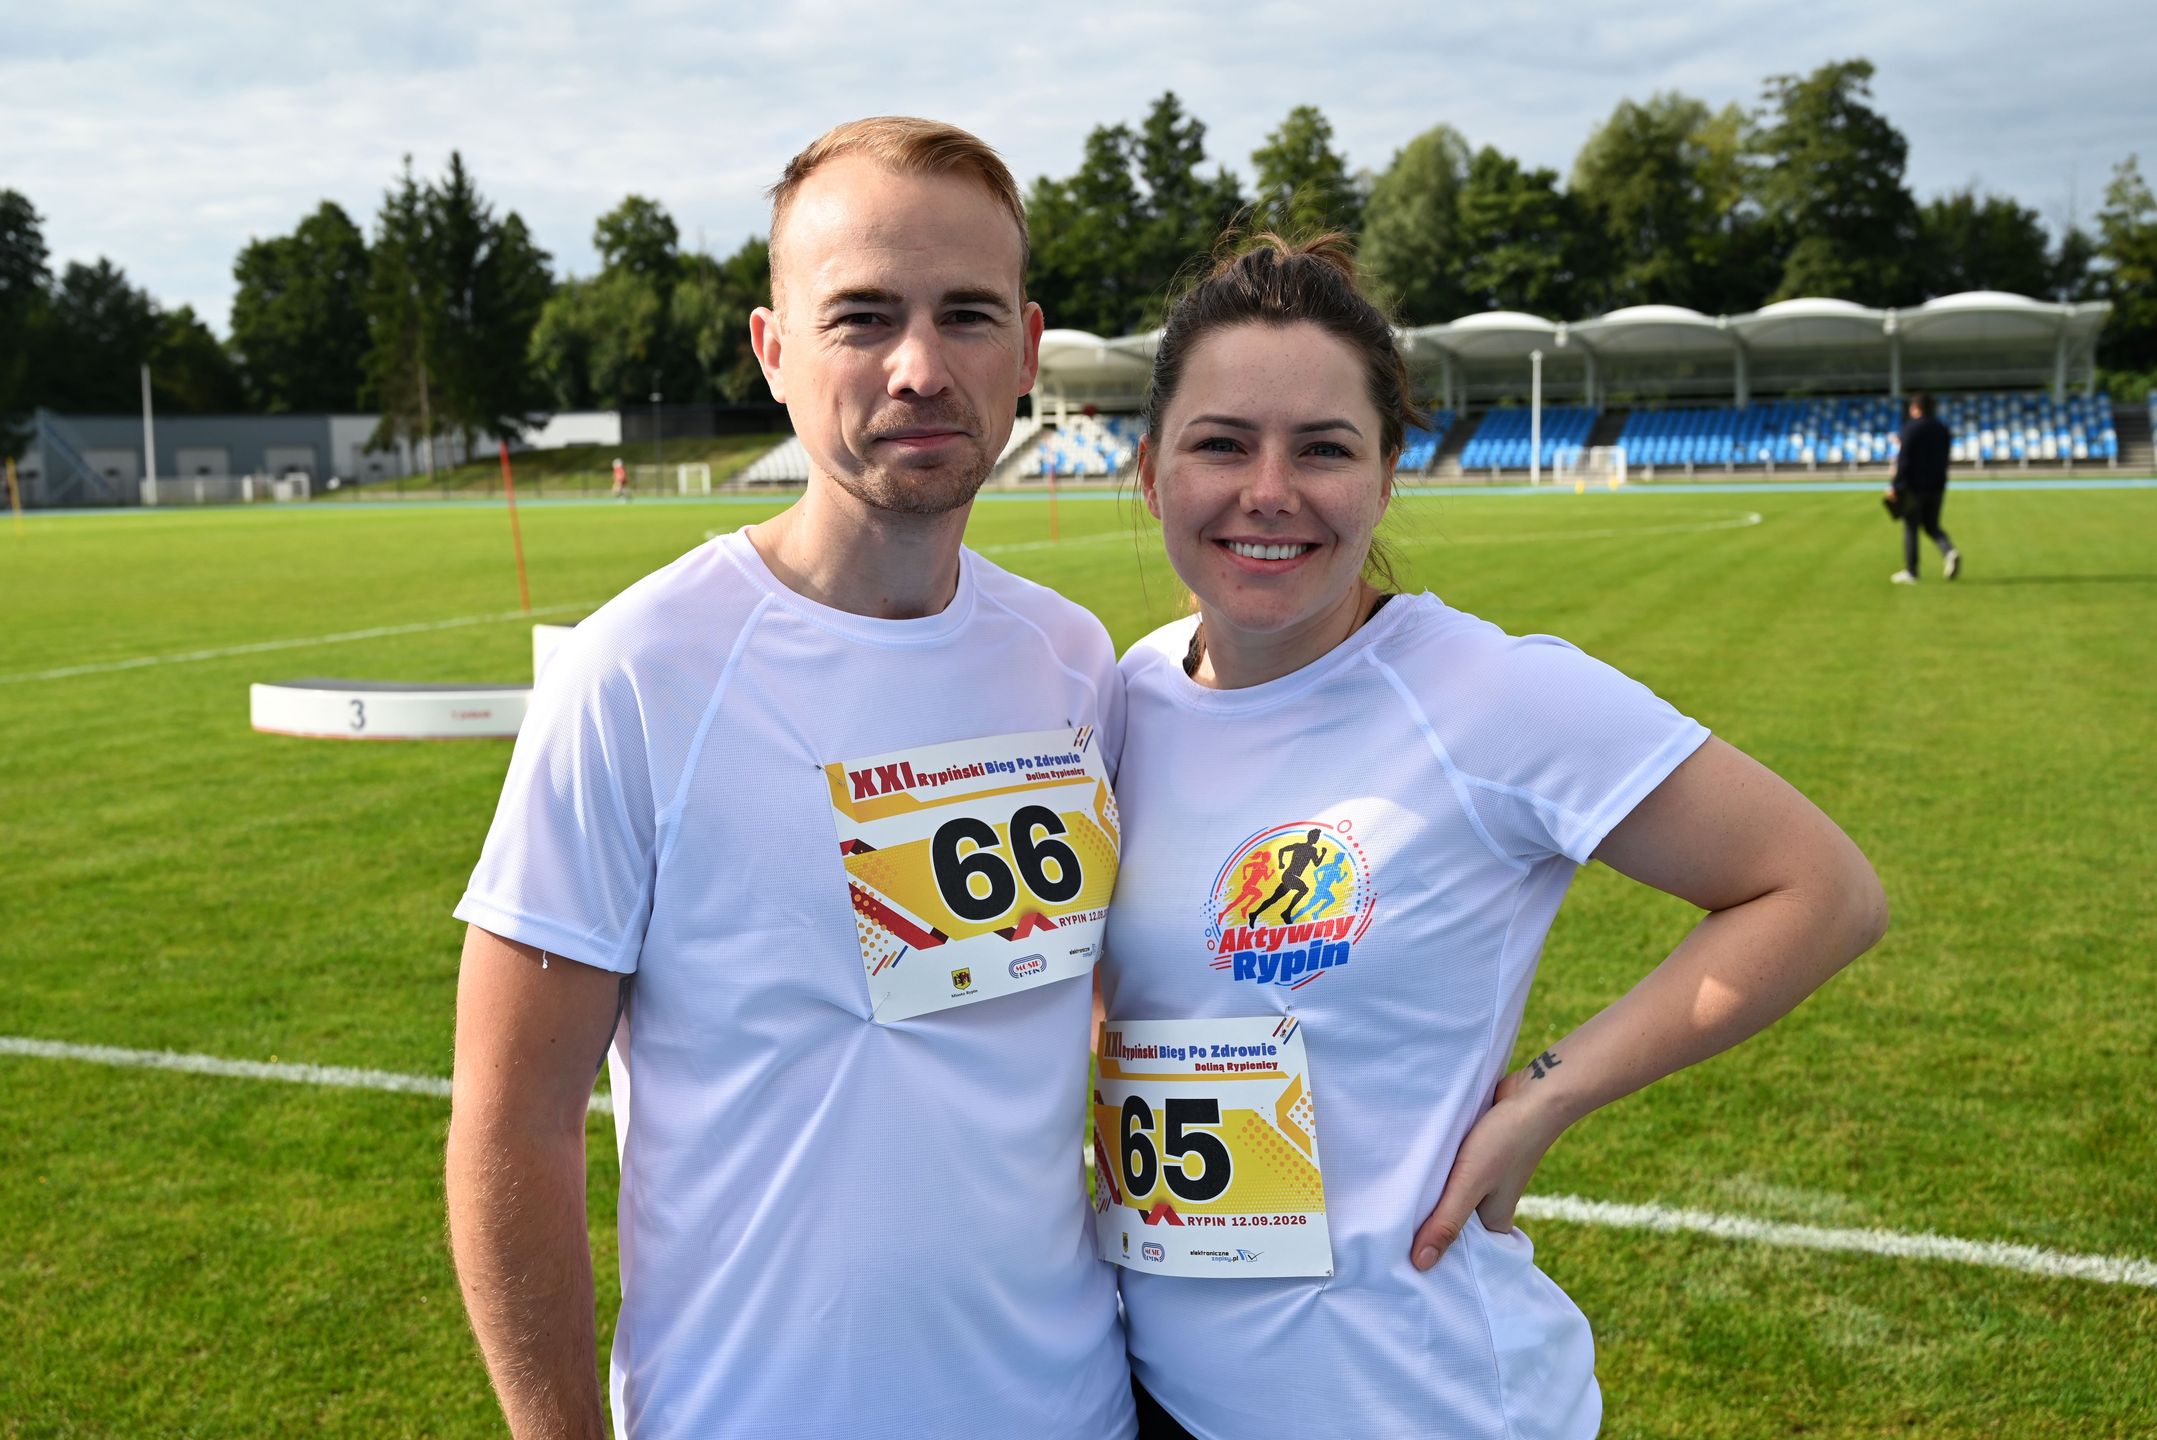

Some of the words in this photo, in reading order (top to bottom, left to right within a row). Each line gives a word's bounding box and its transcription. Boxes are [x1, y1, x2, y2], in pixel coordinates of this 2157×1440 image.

[350, 699, 365, 730] 3
[848, 761, 917, 800] XXI
[916, 763, 986, 788] Rypiński
[984, 760, 1016, 774] Bieg
[1016, 757, 1033, 770] Po
[1034, 752, 1081, 767] Zdrowie
[1050, 767, 1085, 779] Rypienicy
[932, 805, 1082, 921] 66
[1059, 913, 1087, 927] RYPIN
[1218, 915, 1356, 954] Aktywny
[1233, 939, 1350, 984] Rypin
[1104, 1032, 1122, 1057] XXI
[1122, 1043, 1158, 1061] Rypiński
[1159, 1045, 1186, 1061] Bieg
[1189, 1046, 1207, 1058] Po
[1211, 1043, 1277, 1058] Zdrowie
[1226, 1060, 1278, 1072] Rypienicy
[1120, 1095, 1231, 1201] 65
[1187, 1216, 1226, 1227] RYPIN
[1231, 1215, 1307, 1227] 12.09.2026
